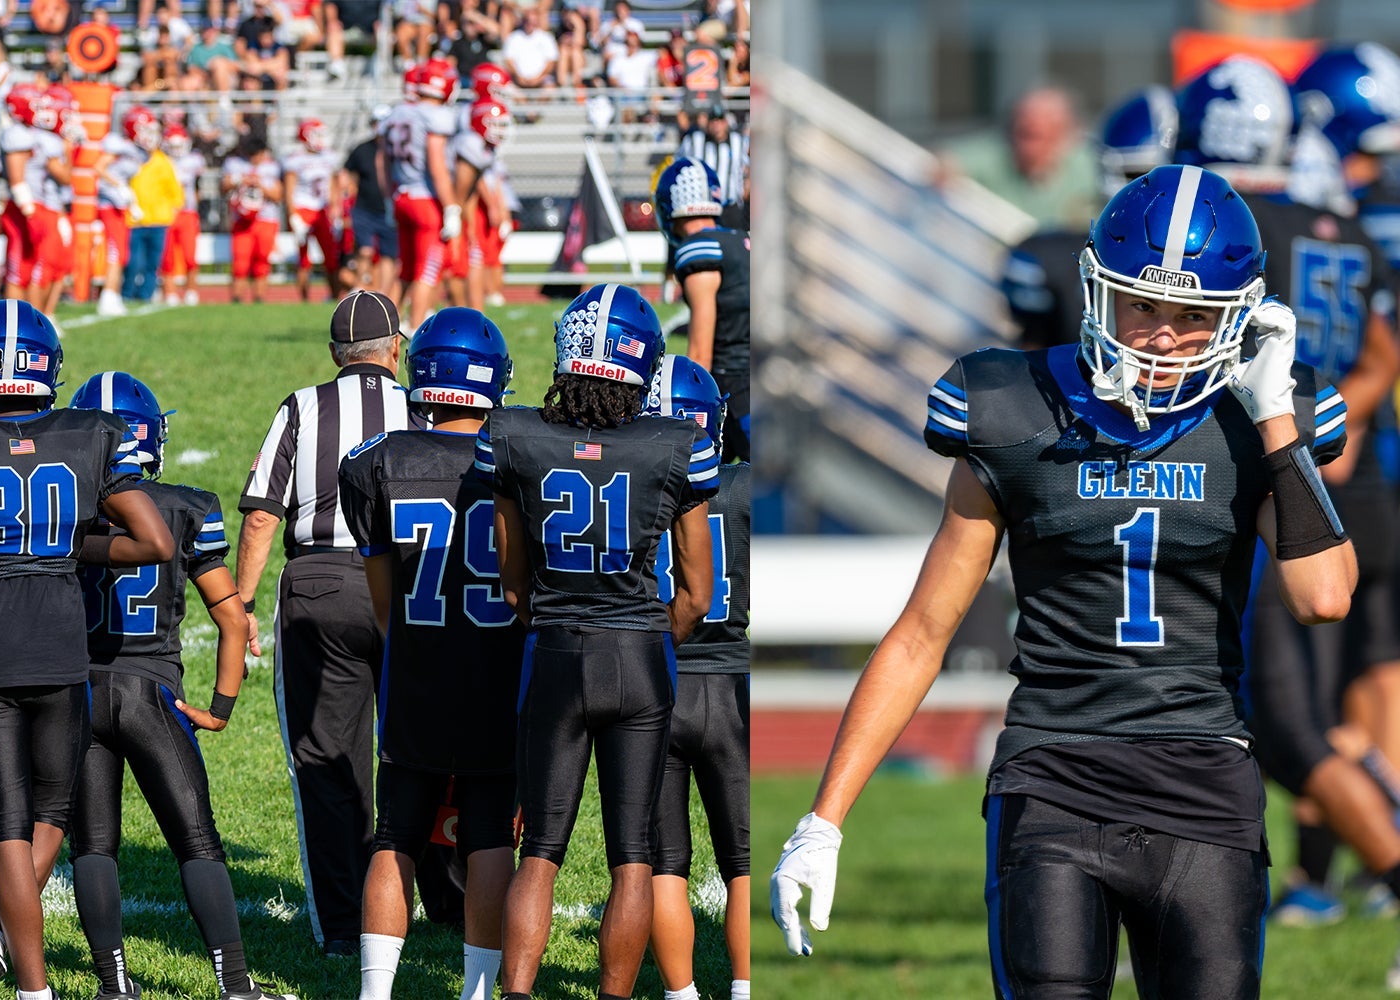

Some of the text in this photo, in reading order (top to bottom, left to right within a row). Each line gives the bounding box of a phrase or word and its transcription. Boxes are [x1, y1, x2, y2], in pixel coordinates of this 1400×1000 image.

[685, 48, 719, 92] 2
[1145, 268, 1193, 289] KNIGHTS
[1290, 235, 1372, 374] 55
[580, 335, 613, 362] 21
[366, 376, 377, 387] S
[571, 359, 626, 381] Riddell
[422, 389, 475, 405] Riddell
[1138, 390, 1163, 401] Ridell
[1077, 460, 1206, 501] GLENN
[540, 468, 634, 575] 21
[1113, 507, 1165, 647] 1
